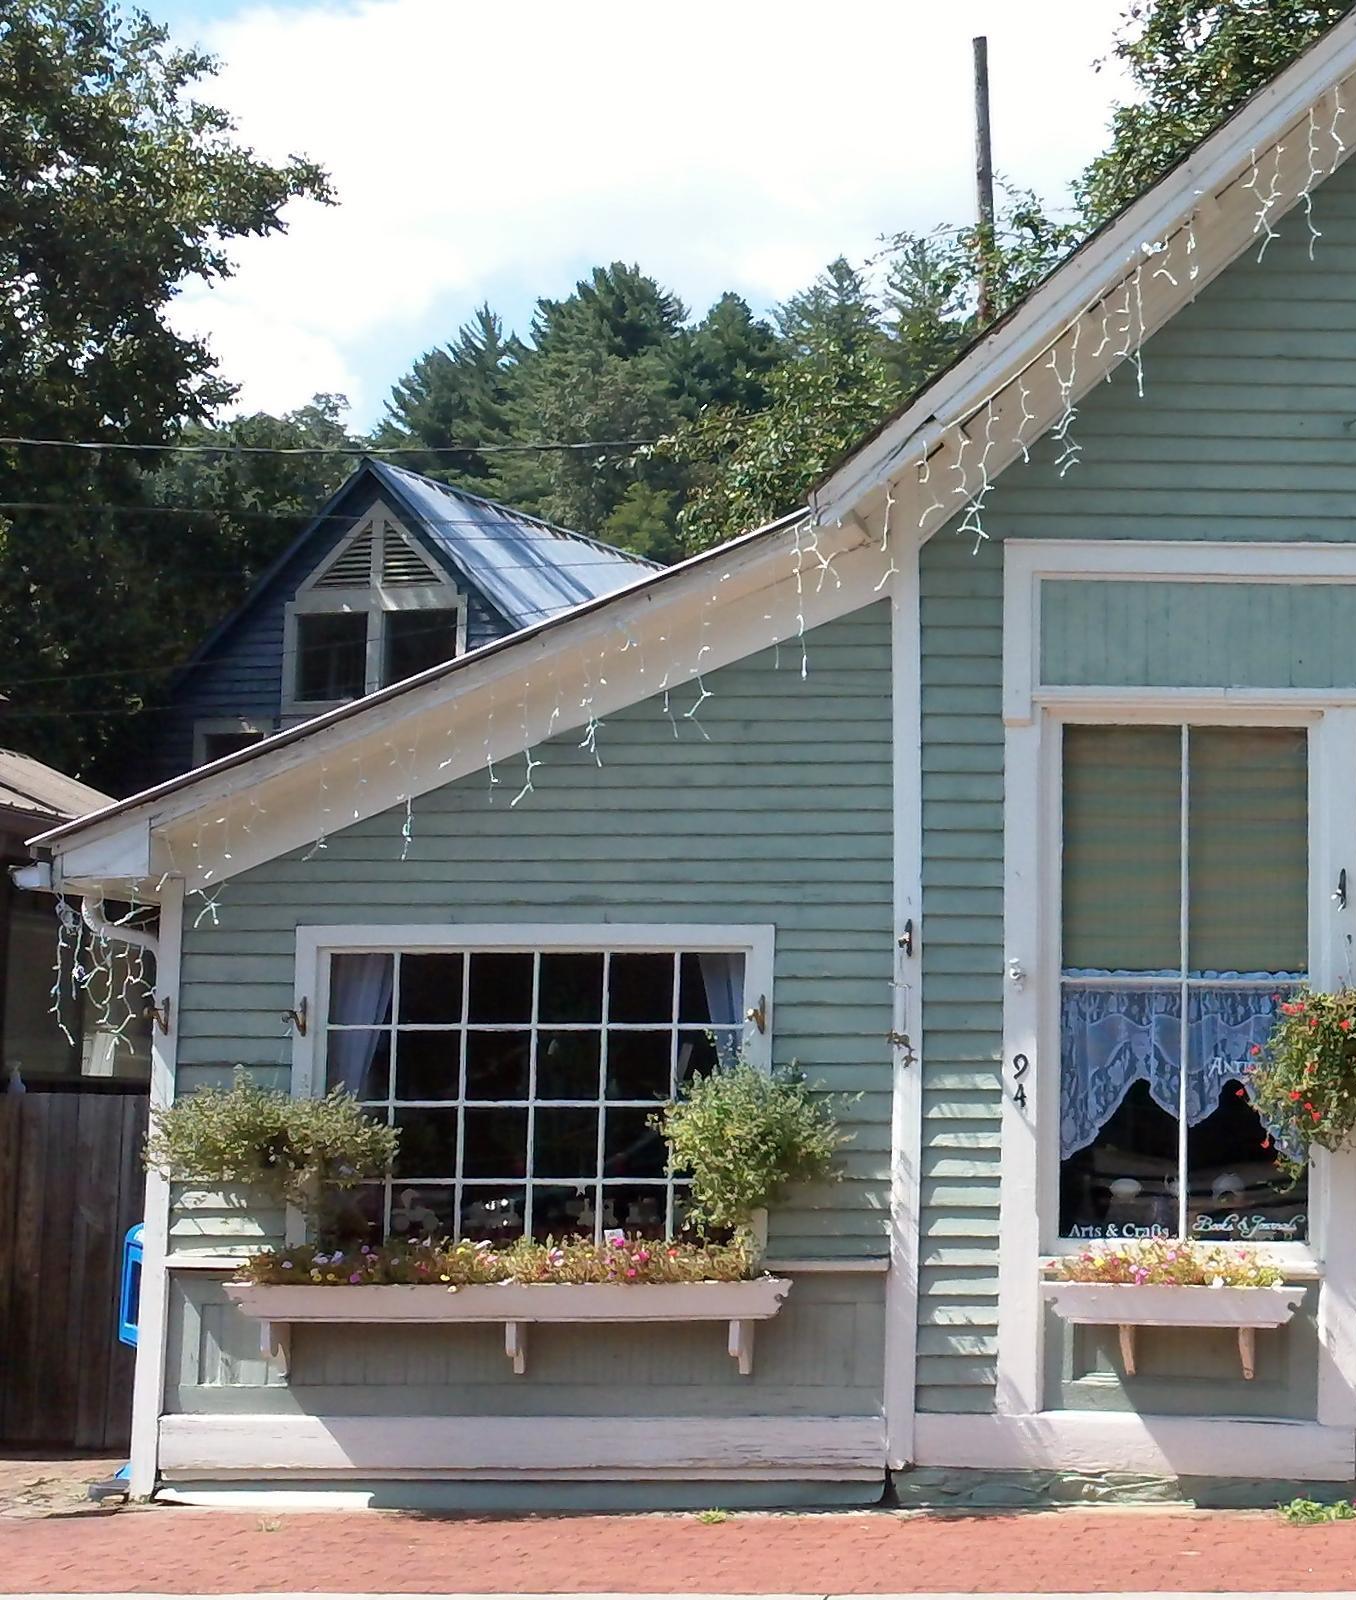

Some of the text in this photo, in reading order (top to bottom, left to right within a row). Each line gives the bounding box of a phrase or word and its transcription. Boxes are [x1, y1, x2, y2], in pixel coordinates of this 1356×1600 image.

[1012, 1053, 1029, 1108] 94
[1068, 1223, 1170, 1239] Arts & Crafts
